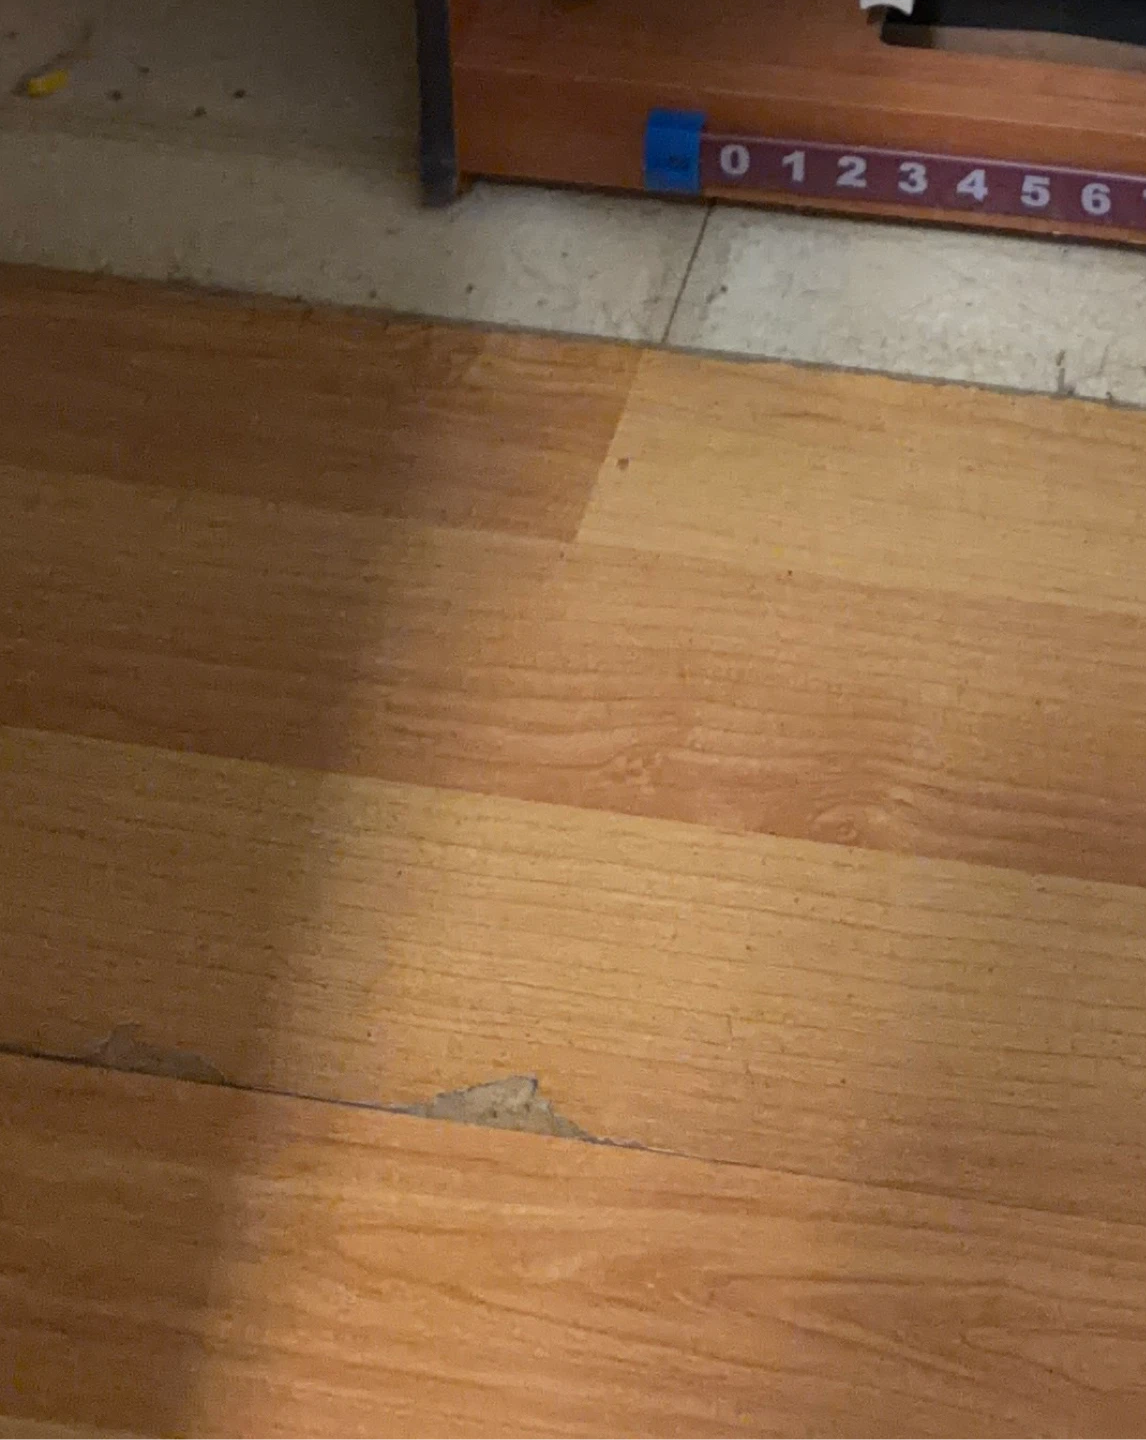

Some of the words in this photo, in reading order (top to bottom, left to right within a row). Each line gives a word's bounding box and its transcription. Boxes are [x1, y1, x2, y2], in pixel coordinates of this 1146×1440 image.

[719, 144, 750, 176] 0
[781, 150, 806, 182] 1
[836, 155, 868, 188] 2
[898, 161, 928, 194] 3
[956, 168, 989, 202] 4
[1020, 174, 1051, 207] 5
[1081, 182, 1112, 215] 6
